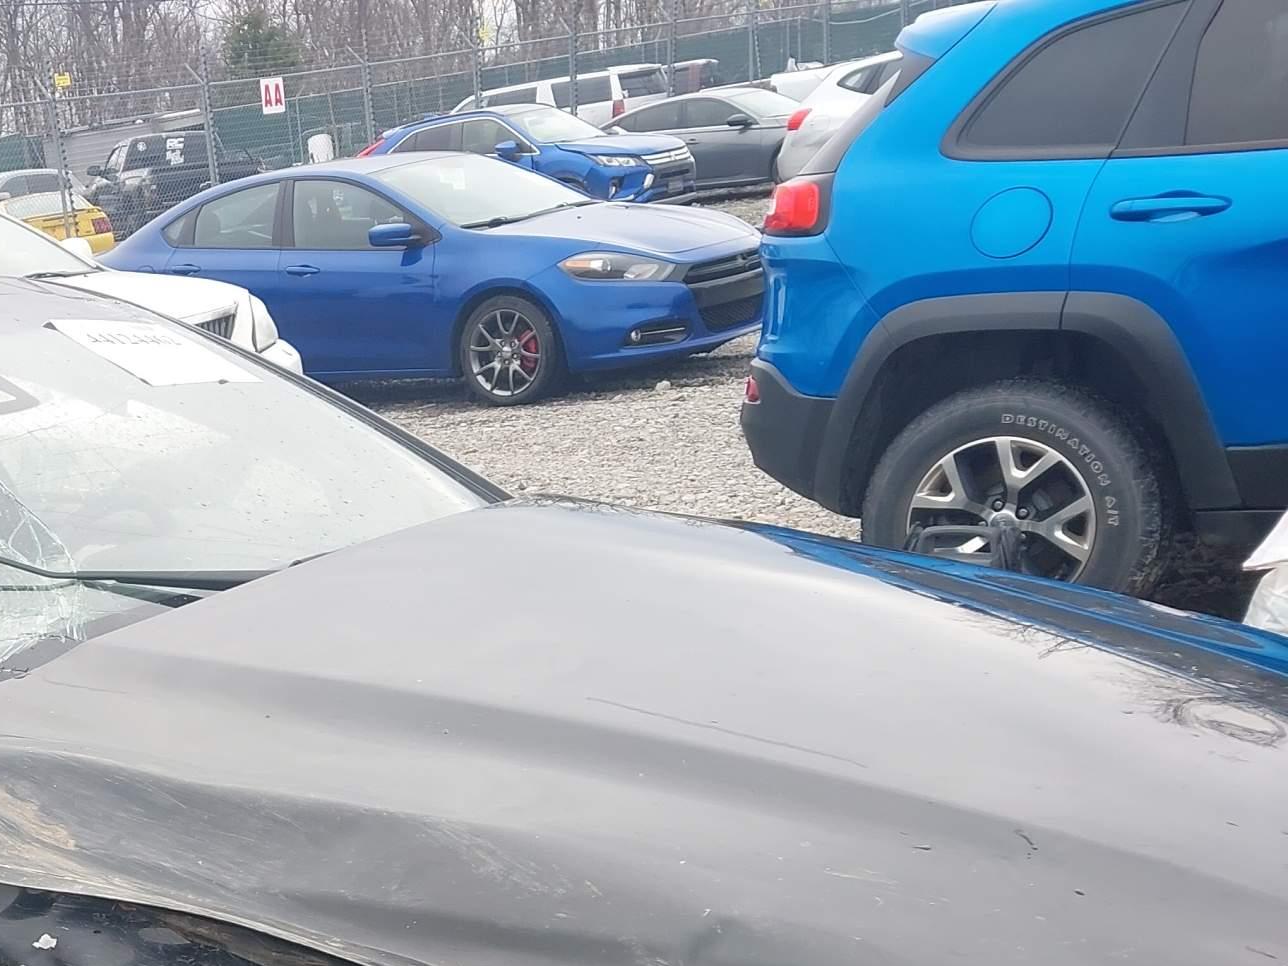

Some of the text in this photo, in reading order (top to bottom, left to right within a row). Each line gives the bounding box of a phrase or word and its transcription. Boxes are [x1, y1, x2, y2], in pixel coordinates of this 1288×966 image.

[264, 83, 283, 108] AA
[1001, 413, 1121, 528] DESTINATION A/T
